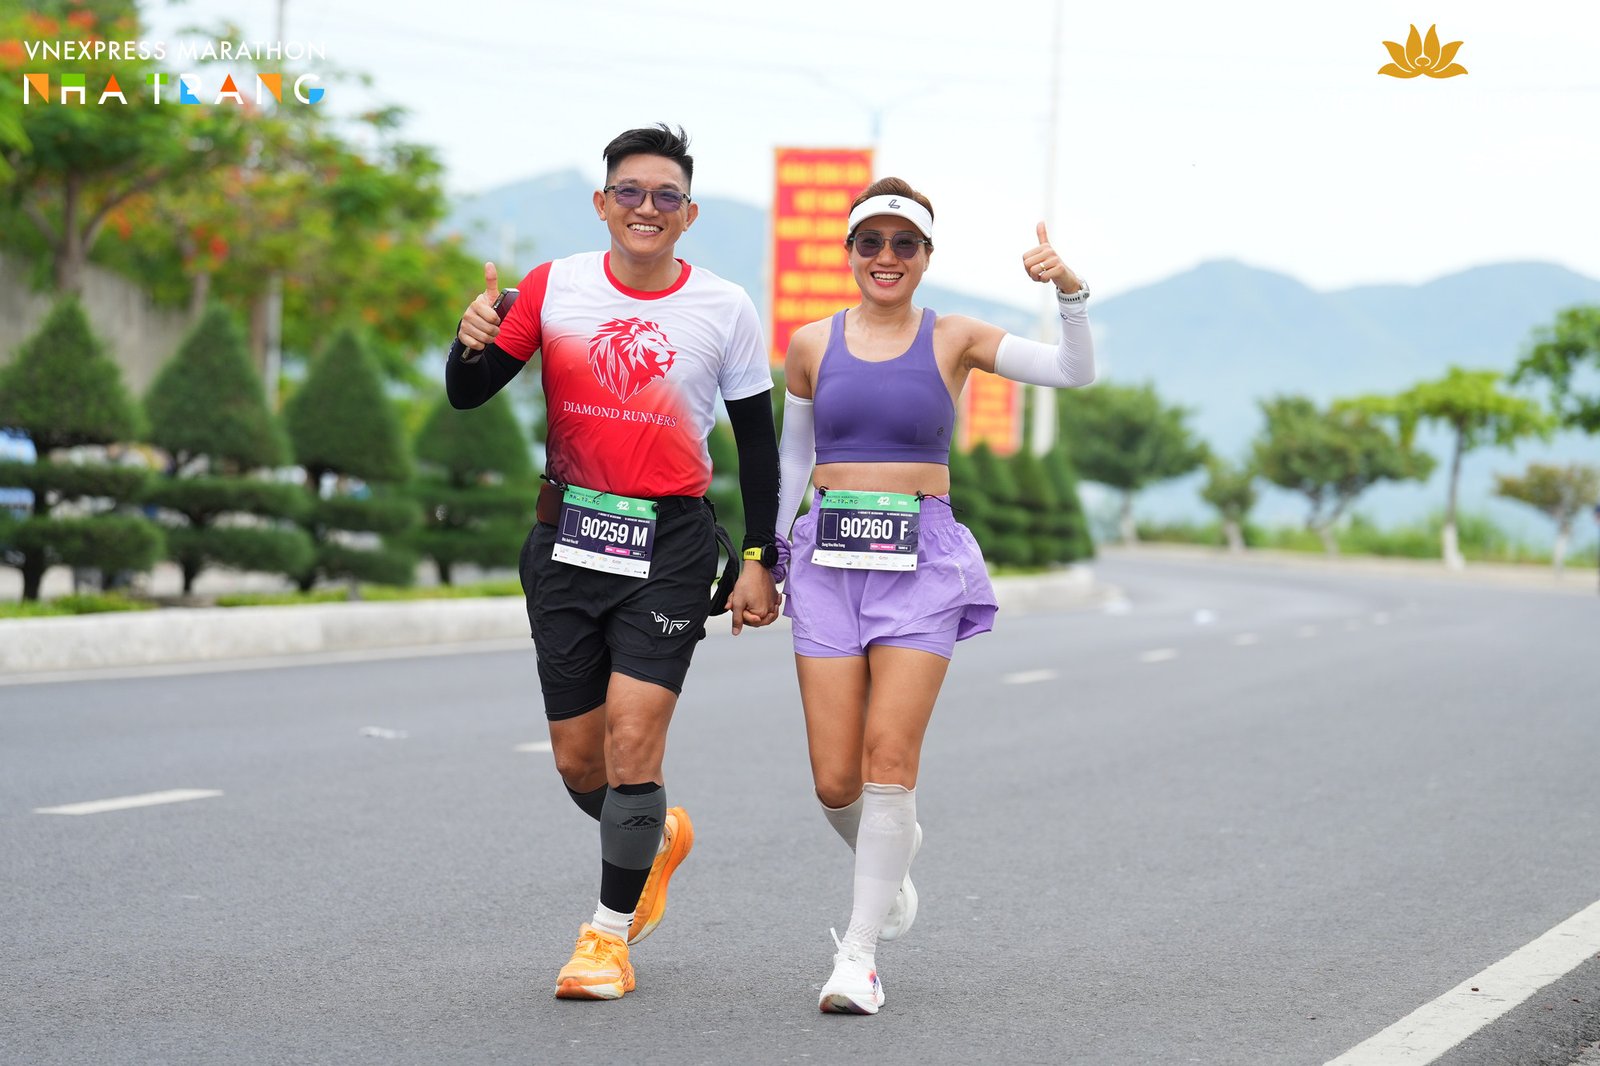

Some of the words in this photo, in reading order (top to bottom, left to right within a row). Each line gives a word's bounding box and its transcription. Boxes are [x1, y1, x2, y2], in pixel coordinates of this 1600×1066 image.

[563, 401, 620, 419] DIAMOND
[622, 409, 677, 427] RUNNERS
[580, 516, 629, 544] 90259
[631, 526, 648, 547] M
[840, 517, 893, 540] 90260
[900, 520, 909, 540] F
